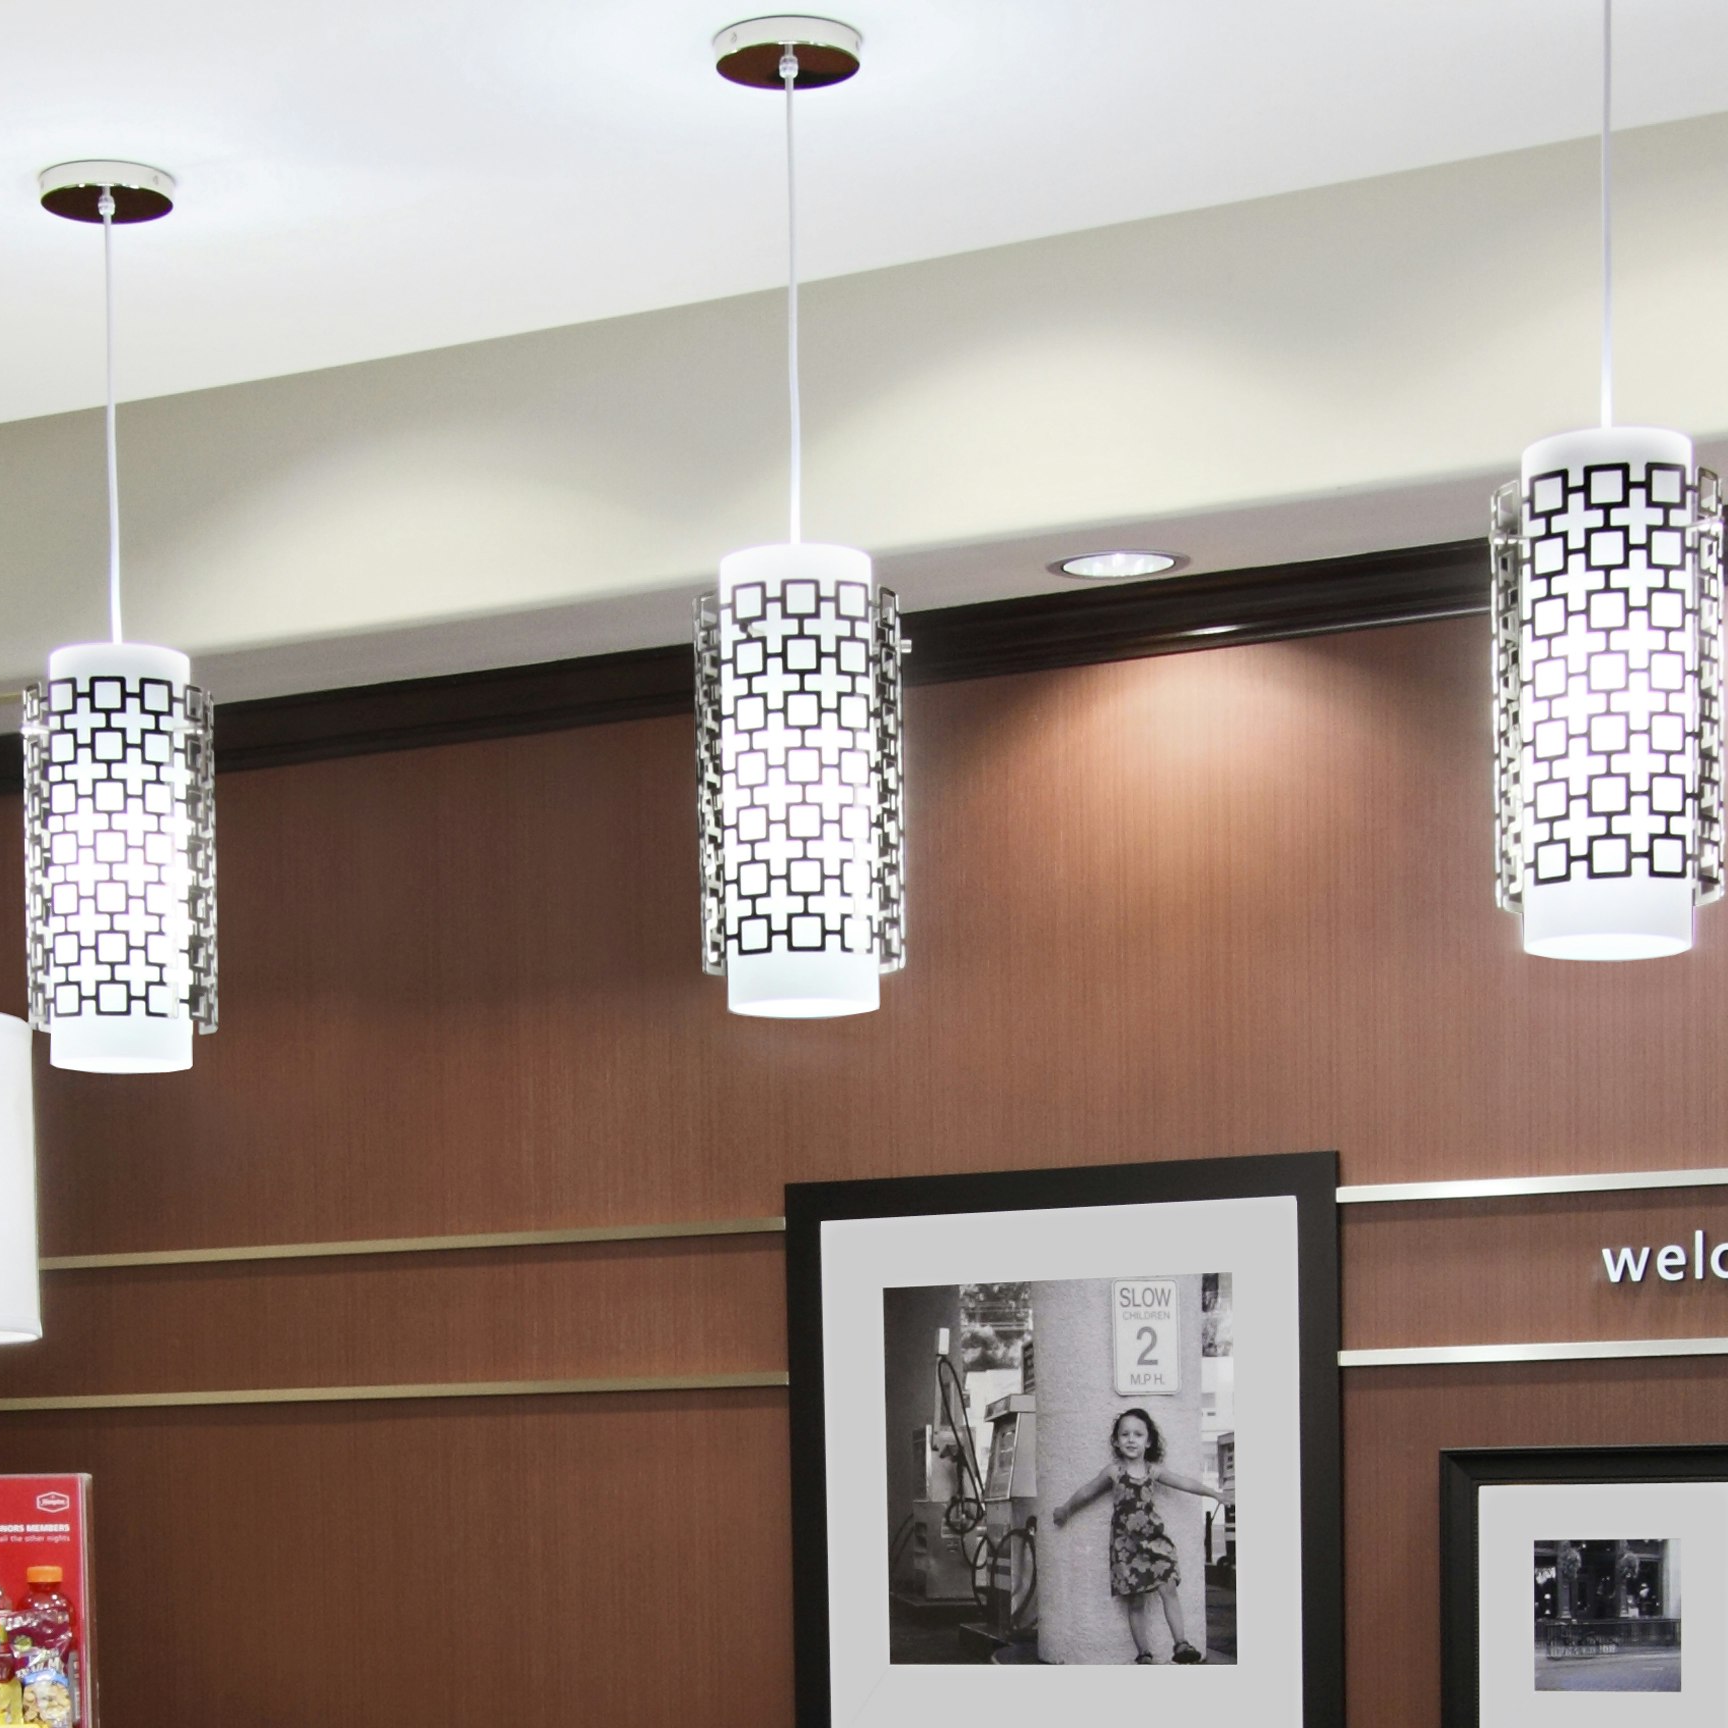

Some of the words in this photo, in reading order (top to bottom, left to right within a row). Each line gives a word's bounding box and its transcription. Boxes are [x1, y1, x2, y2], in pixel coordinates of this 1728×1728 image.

[1119, 1287, 1171, 1308] SLOW
[1122, 1310, 1171, 1321] CHILDREN
[1136, 1326, 1159, 1366] 2
[1130, 1373, 1165, 1385] M.PH.
[26, 1523, 71, 1532] MEMBERS
[46, 1534, 71, 1543] nights
